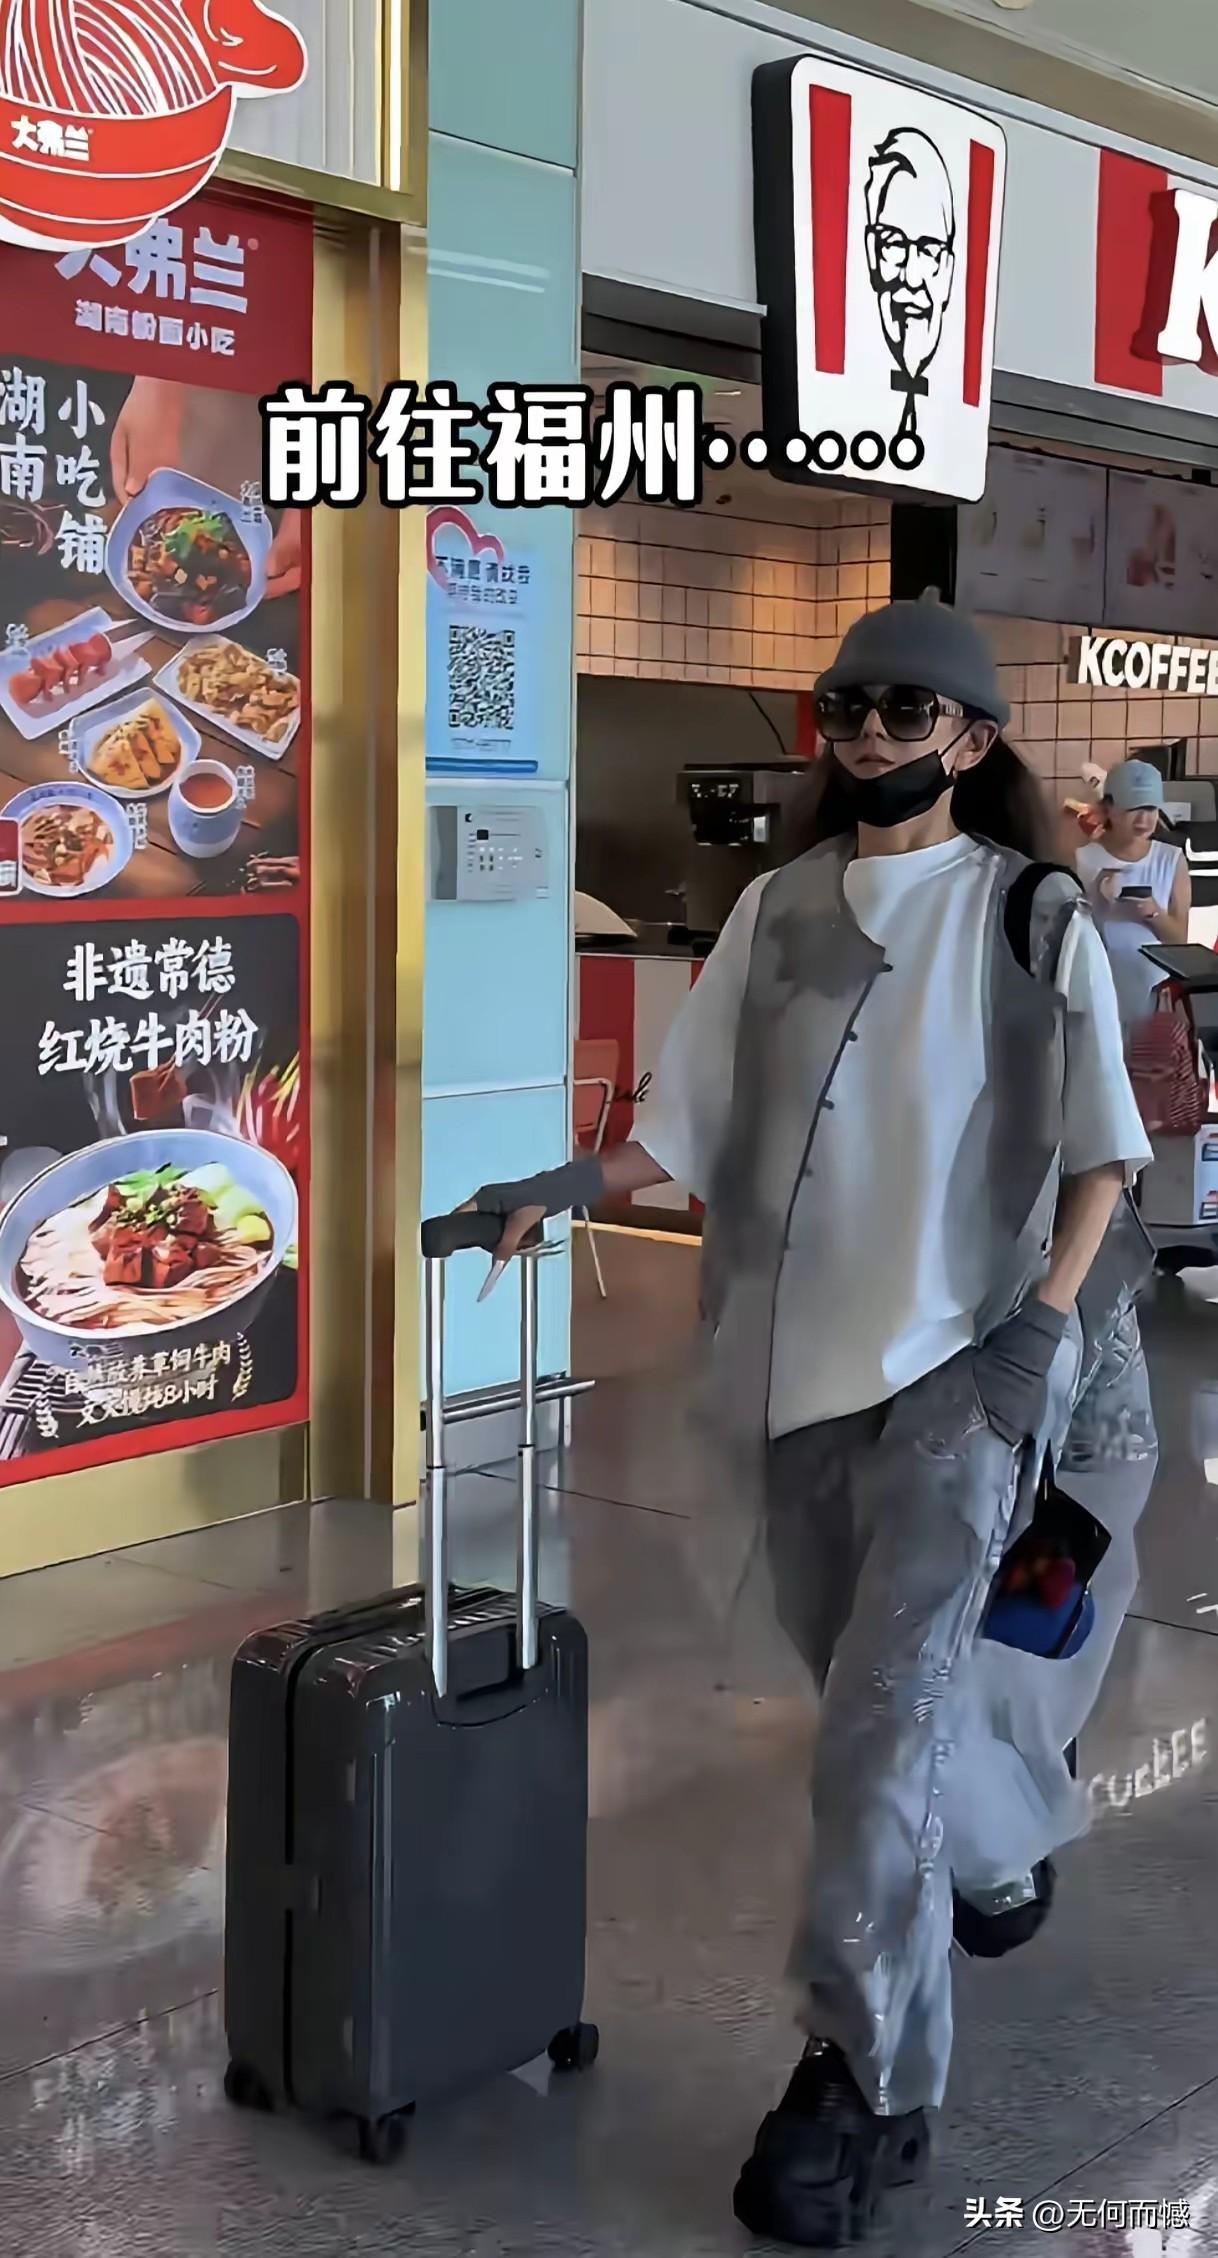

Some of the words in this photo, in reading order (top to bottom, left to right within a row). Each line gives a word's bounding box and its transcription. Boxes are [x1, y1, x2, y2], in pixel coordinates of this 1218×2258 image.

[55, 380, 108, 575] 小吃铺
[63, 936, 236, 1001] 非遗常德
[38, 1008, 258, 1075] 红烧牛肉粉
